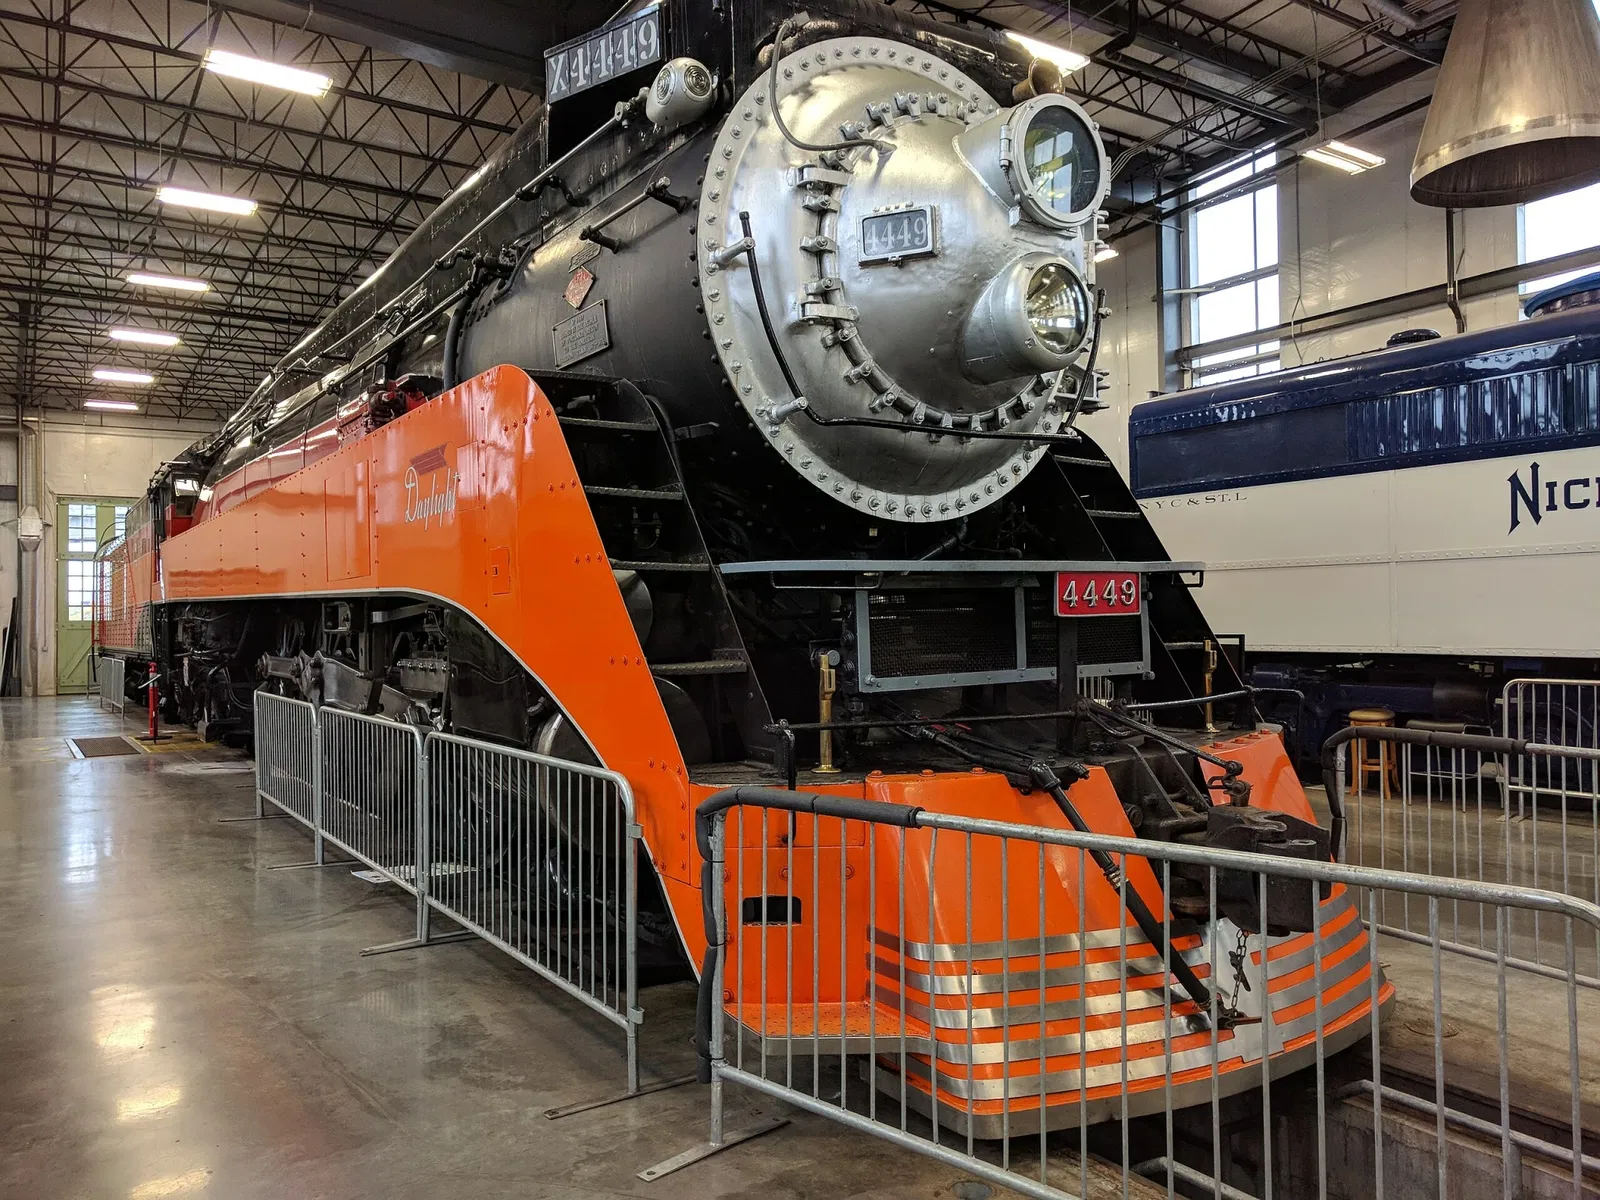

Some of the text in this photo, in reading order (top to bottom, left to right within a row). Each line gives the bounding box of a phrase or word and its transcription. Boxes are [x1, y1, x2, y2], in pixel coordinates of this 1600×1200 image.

[549, 19, 657, 95] X4449
[865, 217, 926, 252] 4449
[404, 466, 460, 531] Daylight
[1507, 461, 1600, 536] NIC
[1063, 579, 1136, 607] 4449
